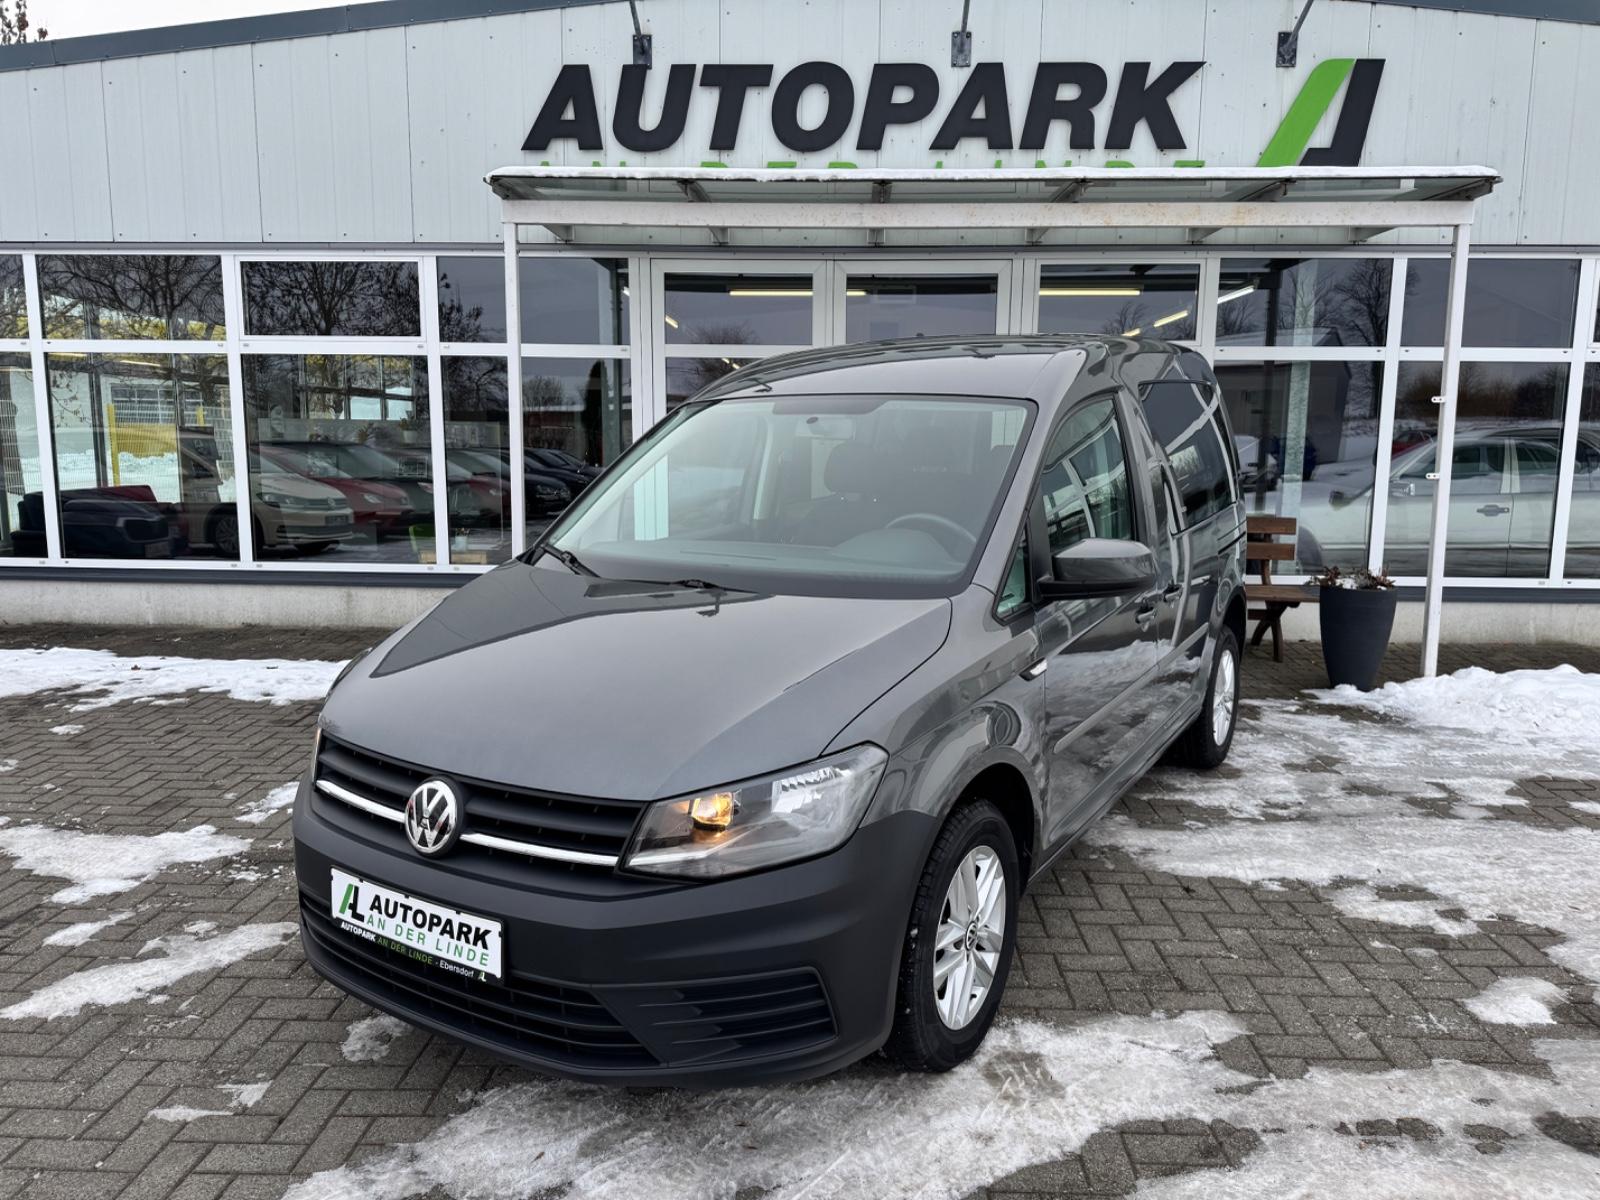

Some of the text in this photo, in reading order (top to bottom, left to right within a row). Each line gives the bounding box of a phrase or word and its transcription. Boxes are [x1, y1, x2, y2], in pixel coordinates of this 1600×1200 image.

[520, 61, 1207, 152] AUTOPARK
[341, 921, 376, 942] AUTOPARK
[377, 936, 388, 948] AN
[390, 941, 406, 954] DER
[408, 949, 433, 965] LINDE
[439, 959, 475, 978] Ebersdorf
[366, 913, 489, 967] AN DER LINDE
[369, 894, 492, 950] AUTOPARK
